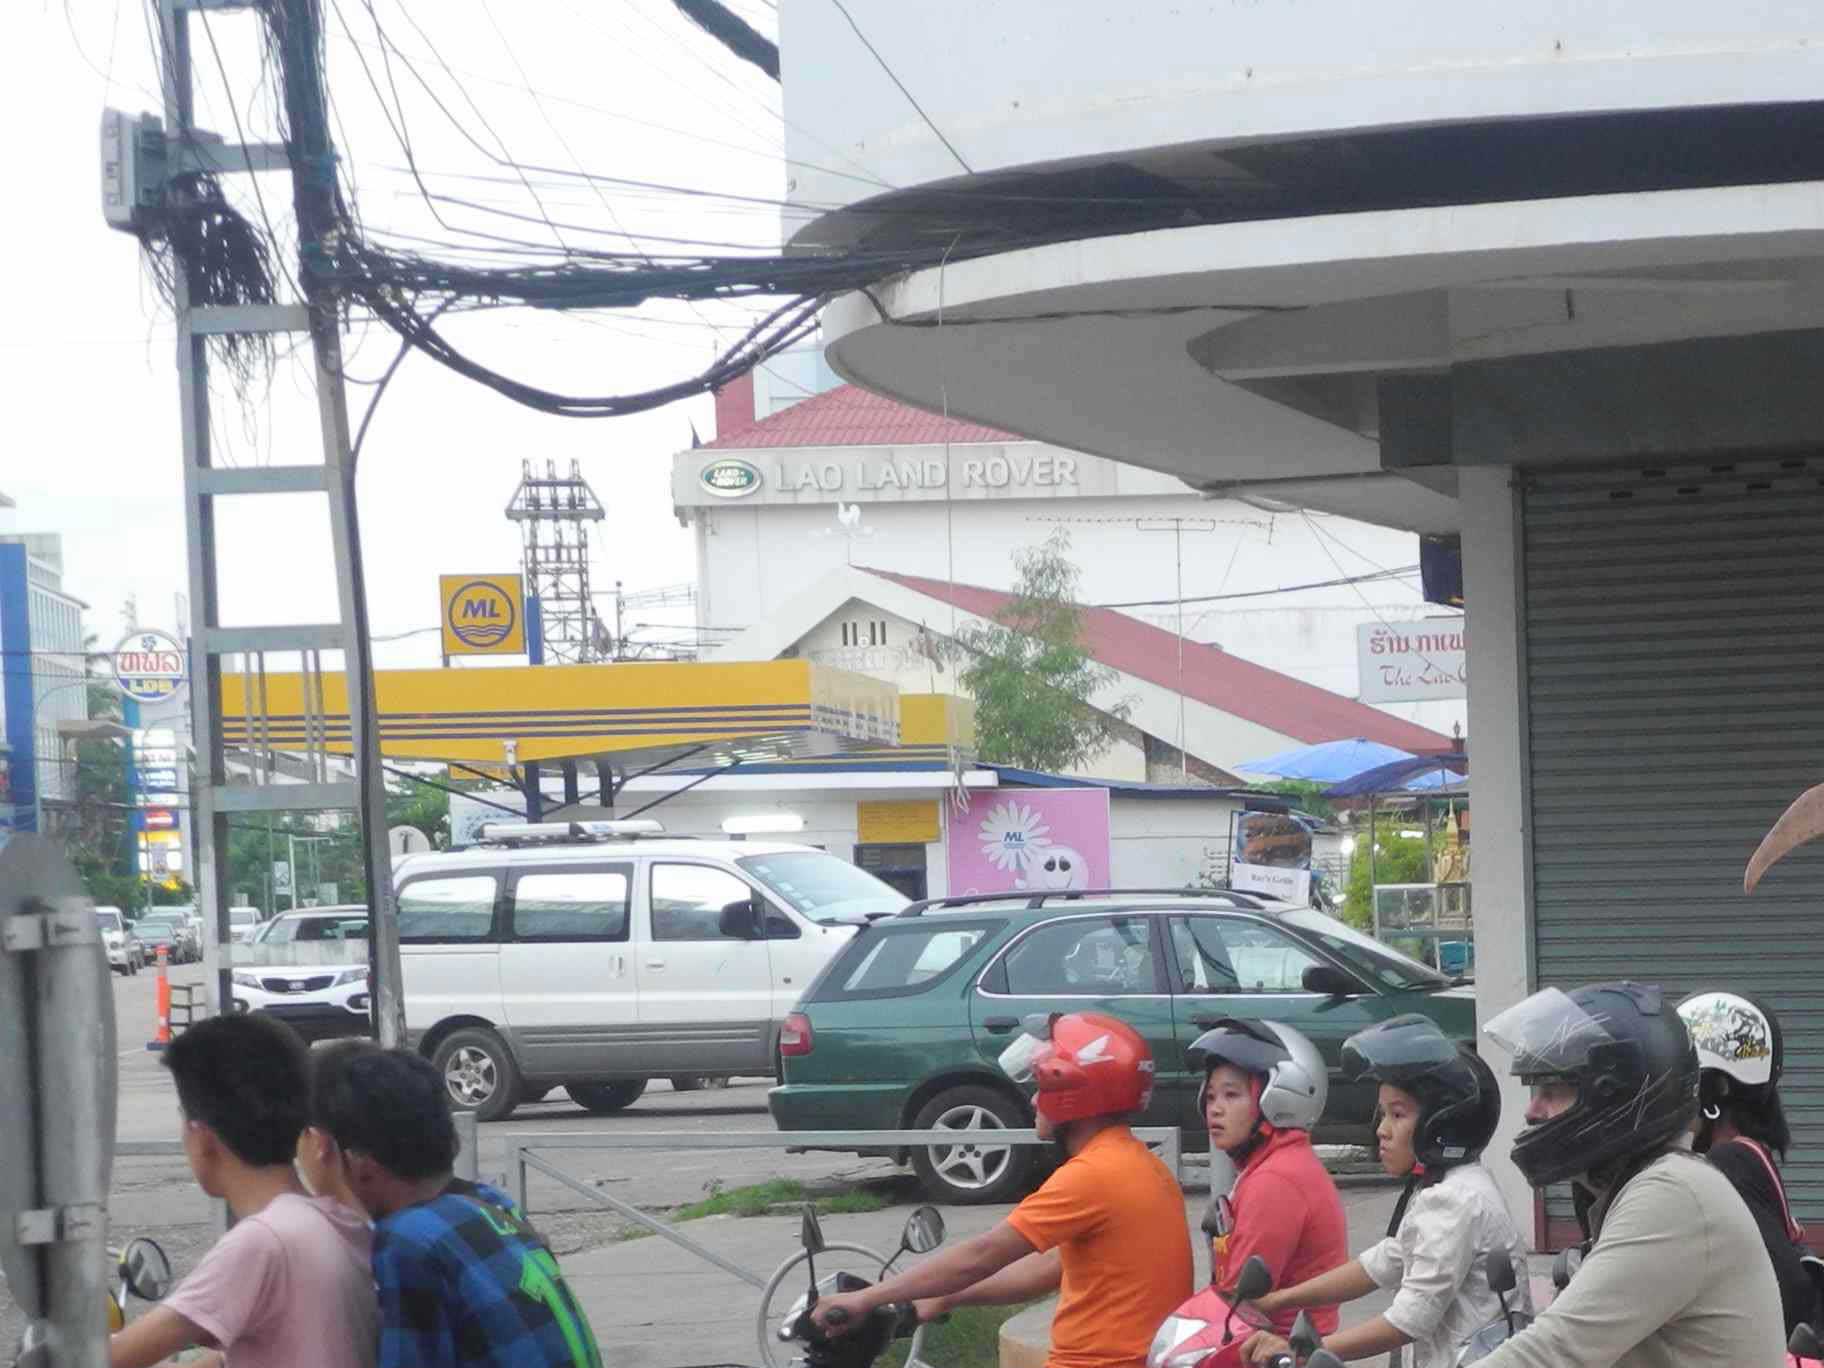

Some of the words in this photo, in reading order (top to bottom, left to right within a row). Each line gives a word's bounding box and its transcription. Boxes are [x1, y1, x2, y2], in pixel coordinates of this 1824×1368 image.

[775, 461, 844, 492] LAO
[857, 459, 947, 490] LAND
[962, 455, 1079, 488] ROVER
[462, 598, 501, 618] ML
[1003, 831, 1025, 842] ML
